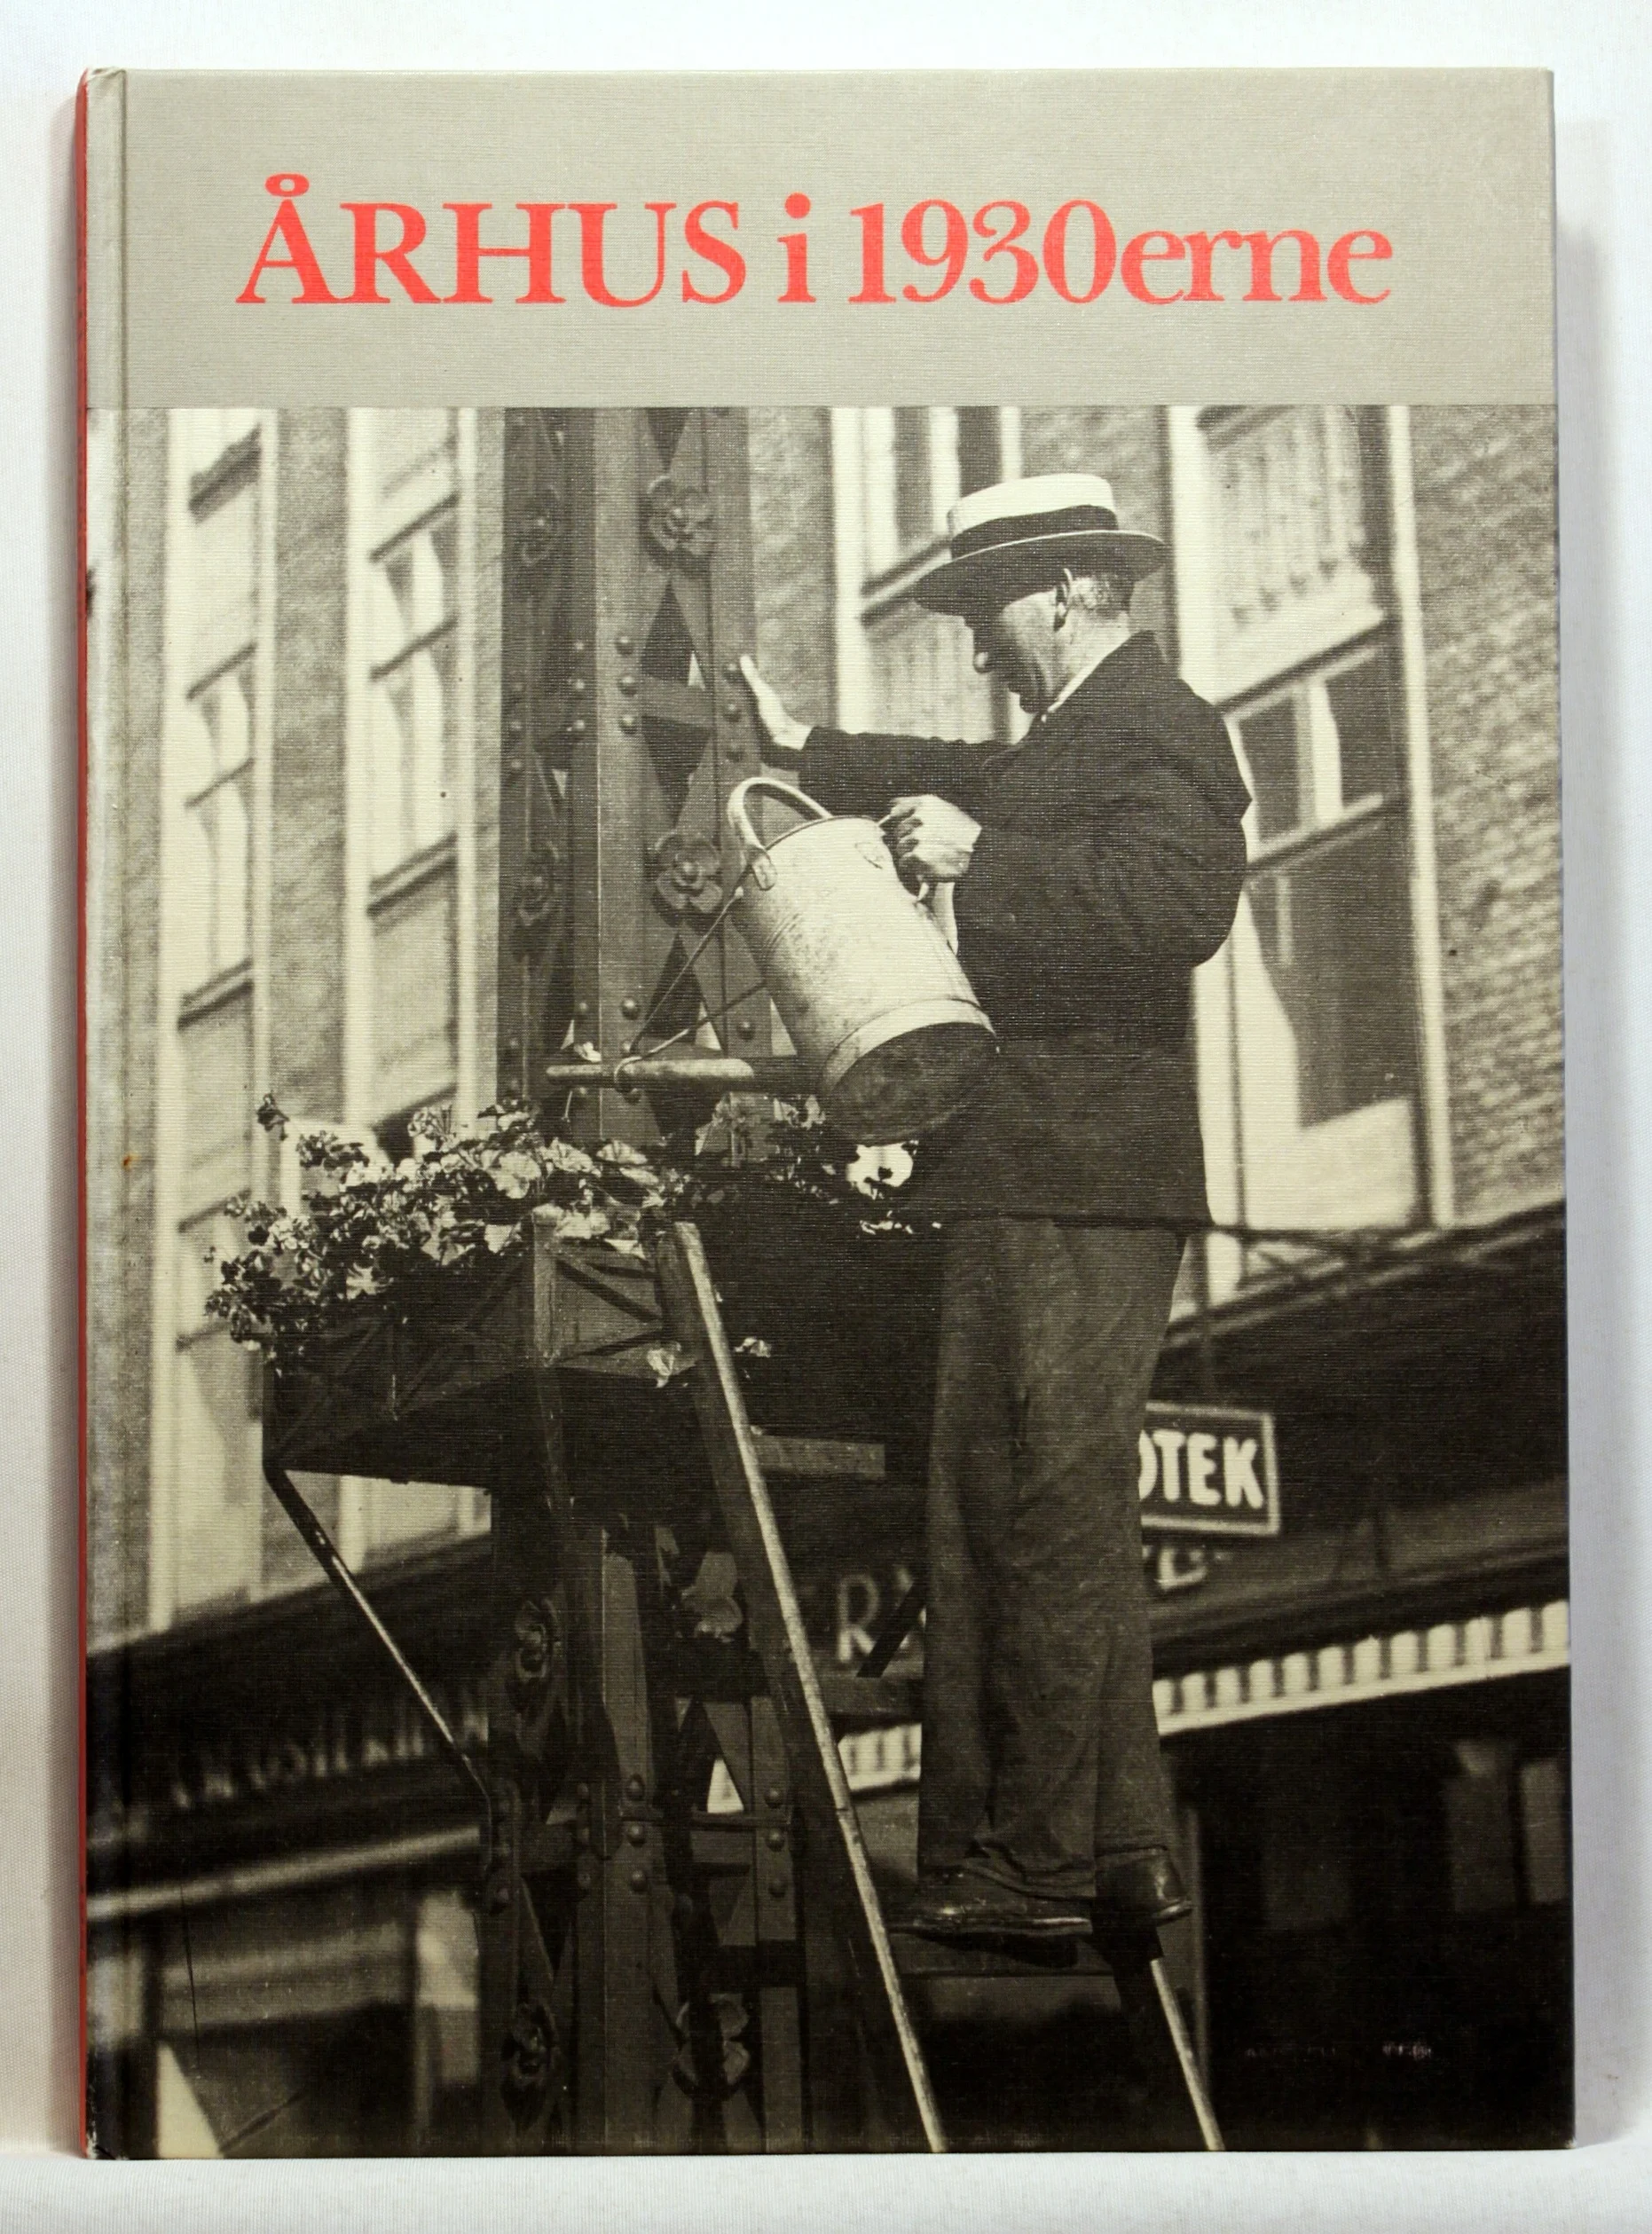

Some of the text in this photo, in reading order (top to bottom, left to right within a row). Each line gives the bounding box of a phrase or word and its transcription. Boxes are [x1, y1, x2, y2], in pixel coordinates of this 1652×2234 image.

[236, 173, 1392, 307] ÅRHUS i 1930erne
